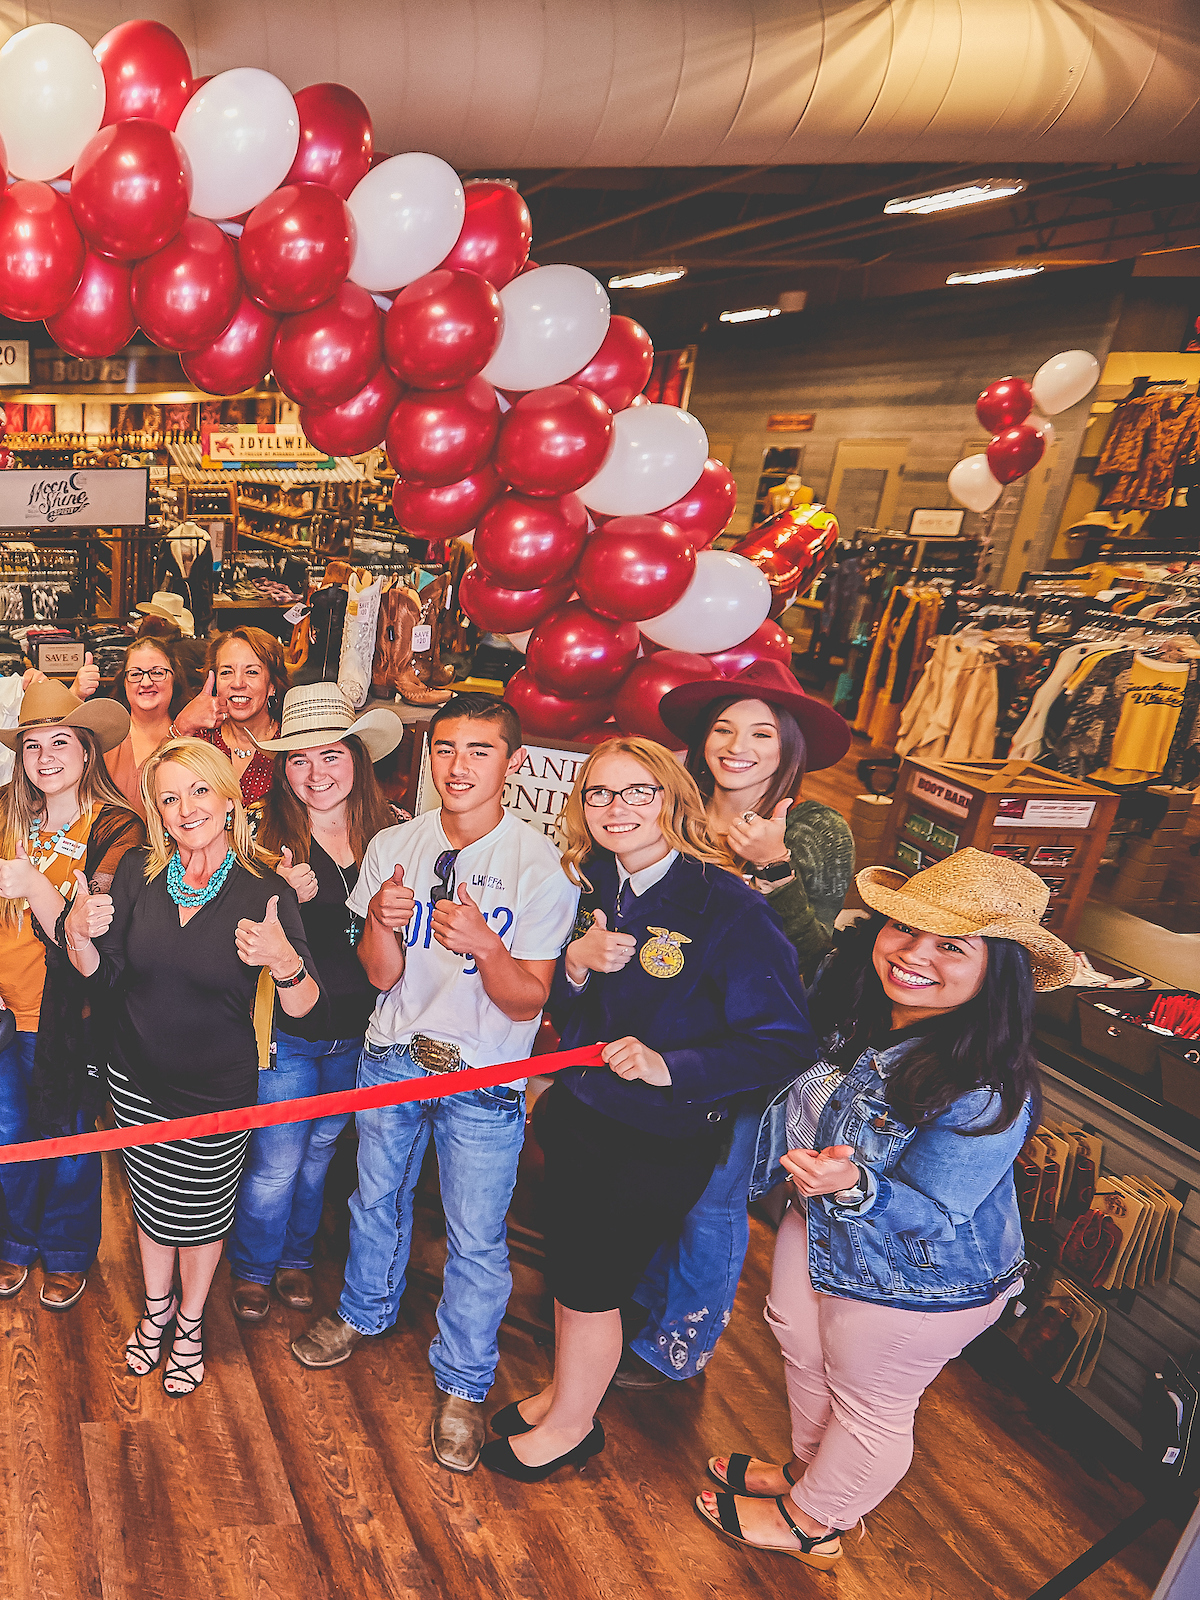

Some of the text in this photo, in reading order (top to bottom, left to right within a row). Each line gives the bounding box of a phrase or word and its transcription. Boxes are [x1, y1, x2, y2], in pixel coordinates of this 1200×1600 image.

[27, 480, 69, 506] Moon
[39, 491, 89, 515] Shine
[414, 630, 430, 638] SAVE
[45, 653, 79, 662] SAVE $5
[917, 778, 943, 796] BOOT
[488, 875, 503, 886] FFA
